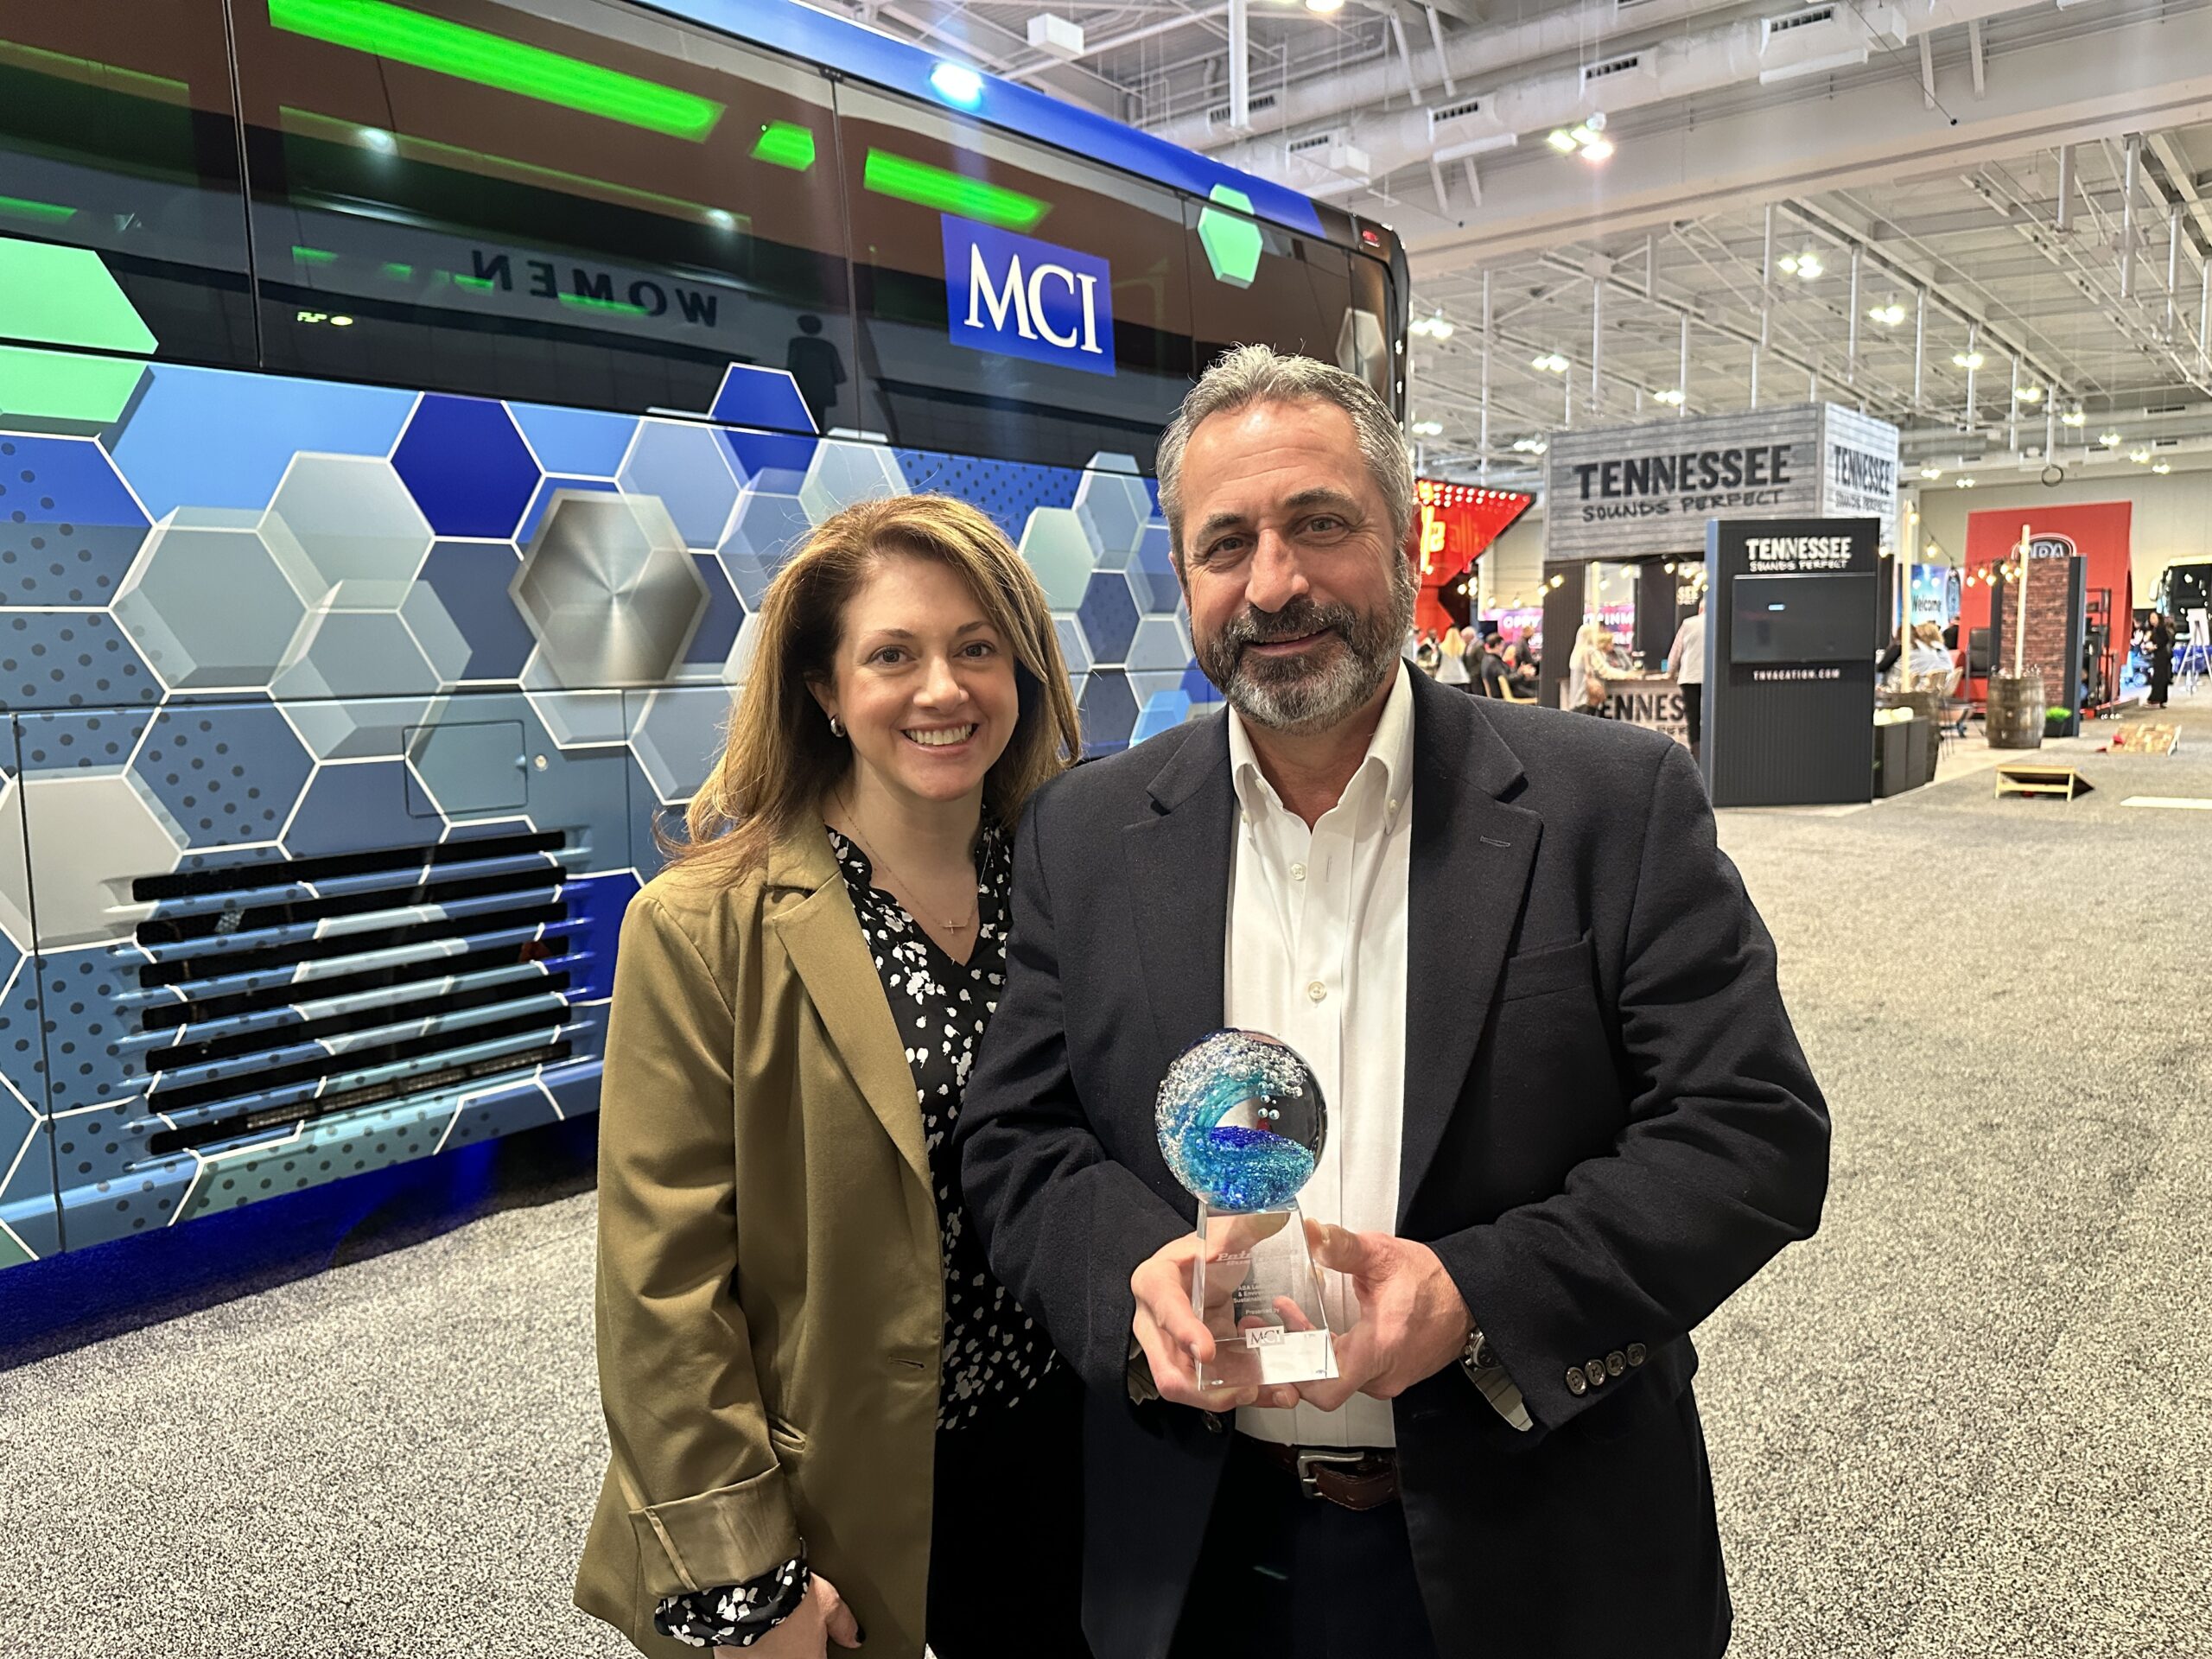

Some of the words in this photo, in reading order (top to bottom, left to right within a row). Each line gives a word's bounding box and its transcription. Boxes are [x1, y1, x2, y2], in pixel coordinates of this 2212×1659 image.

[964, 242, 1103, 354] MCI
[1573, 445, 1791, 499] TENNESSEE
[1834, 444, 1890, 497] TENNESSEE
[1582, 500, 1669, 522] SOUNDS
[1681, 489, 1783, 512] PERFECT
[1745, 537, 1853, 560] TENNESSEE
[1750, 560, 1796, 572] SOUNDS
[1798, 558, 1848, 570] PERFECT
[1911, 594, 1942, 613] Welcome
[1251, 1329, 1281, 1345] MCI
